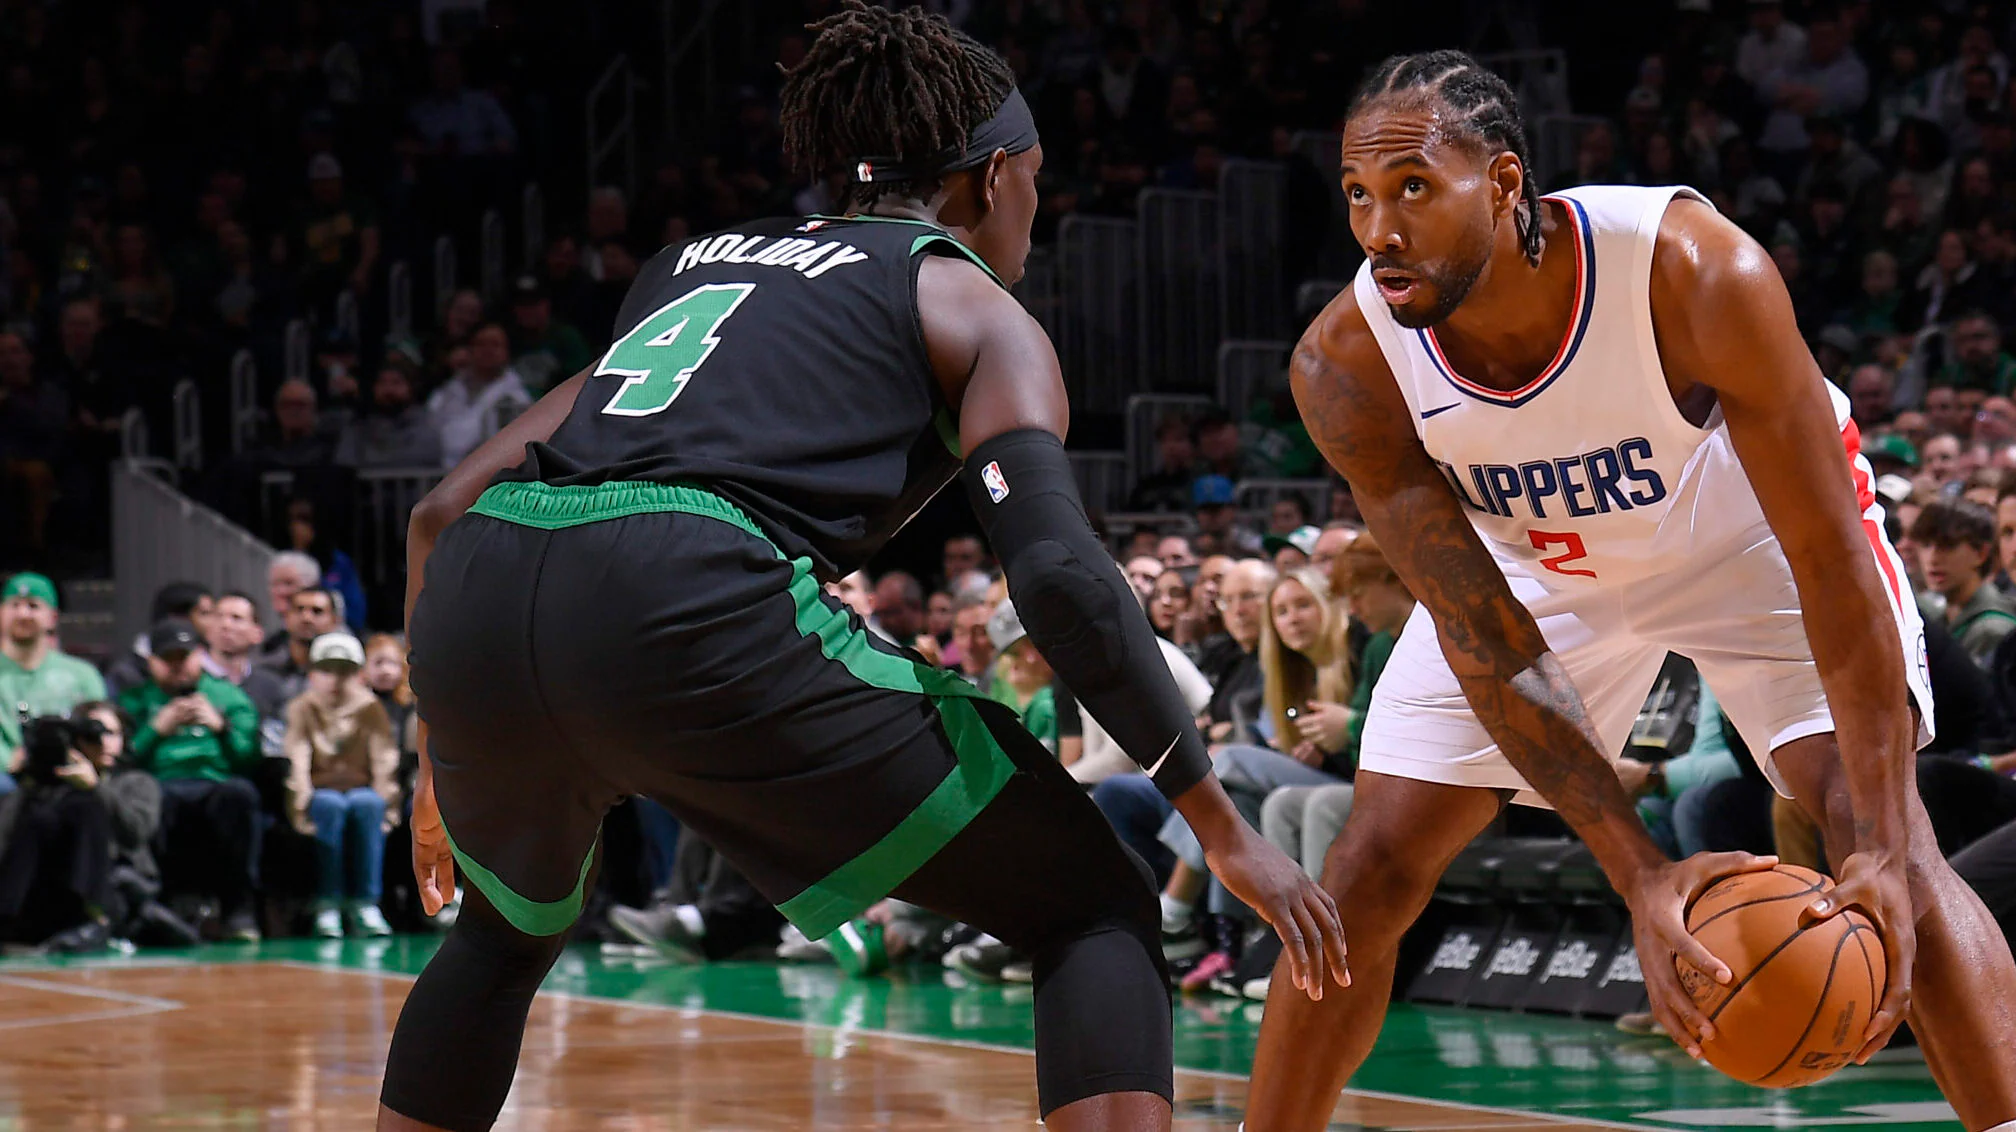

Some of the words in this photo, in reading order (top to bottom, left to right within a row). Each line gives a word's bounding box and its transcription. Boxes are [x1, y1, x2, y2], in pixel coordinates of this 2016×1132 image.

[672, 233, 869, 280] HOLIDAY
[593, 282, 757, 417] 4
[1436, 437, 1667, 518] LIPPERS
[1527, 529, 1598, 579] 2
